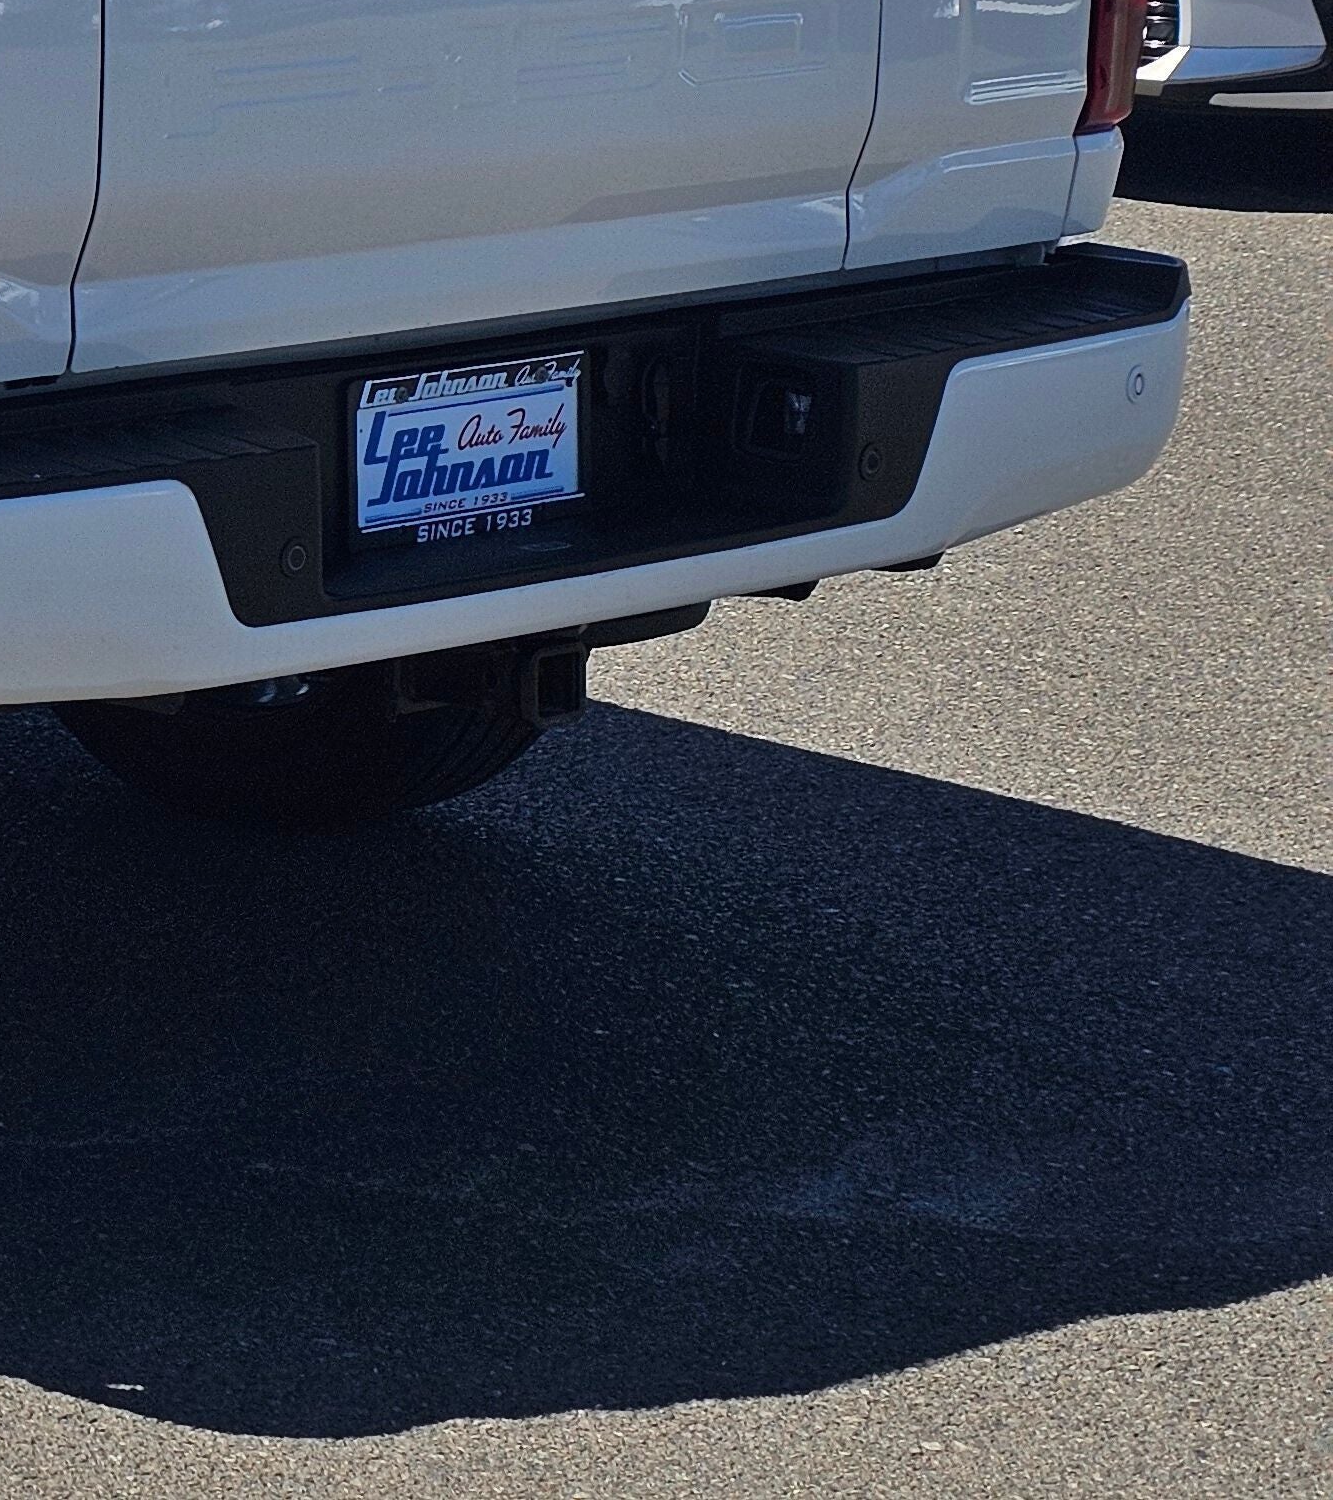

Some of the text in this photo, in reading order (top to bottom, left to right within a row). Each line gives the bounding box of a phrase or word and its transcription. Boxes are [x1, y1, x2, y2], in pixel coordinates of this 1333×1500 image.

[408, 370, 508, 401] Johnson
[363, 403, 567, 466] Lee Auto Family
[366, 443, 554, 507] Johnson
[423, 492, 508, 513] SINCE 1933
[416, 508, 533, 543] SINCE 1933
